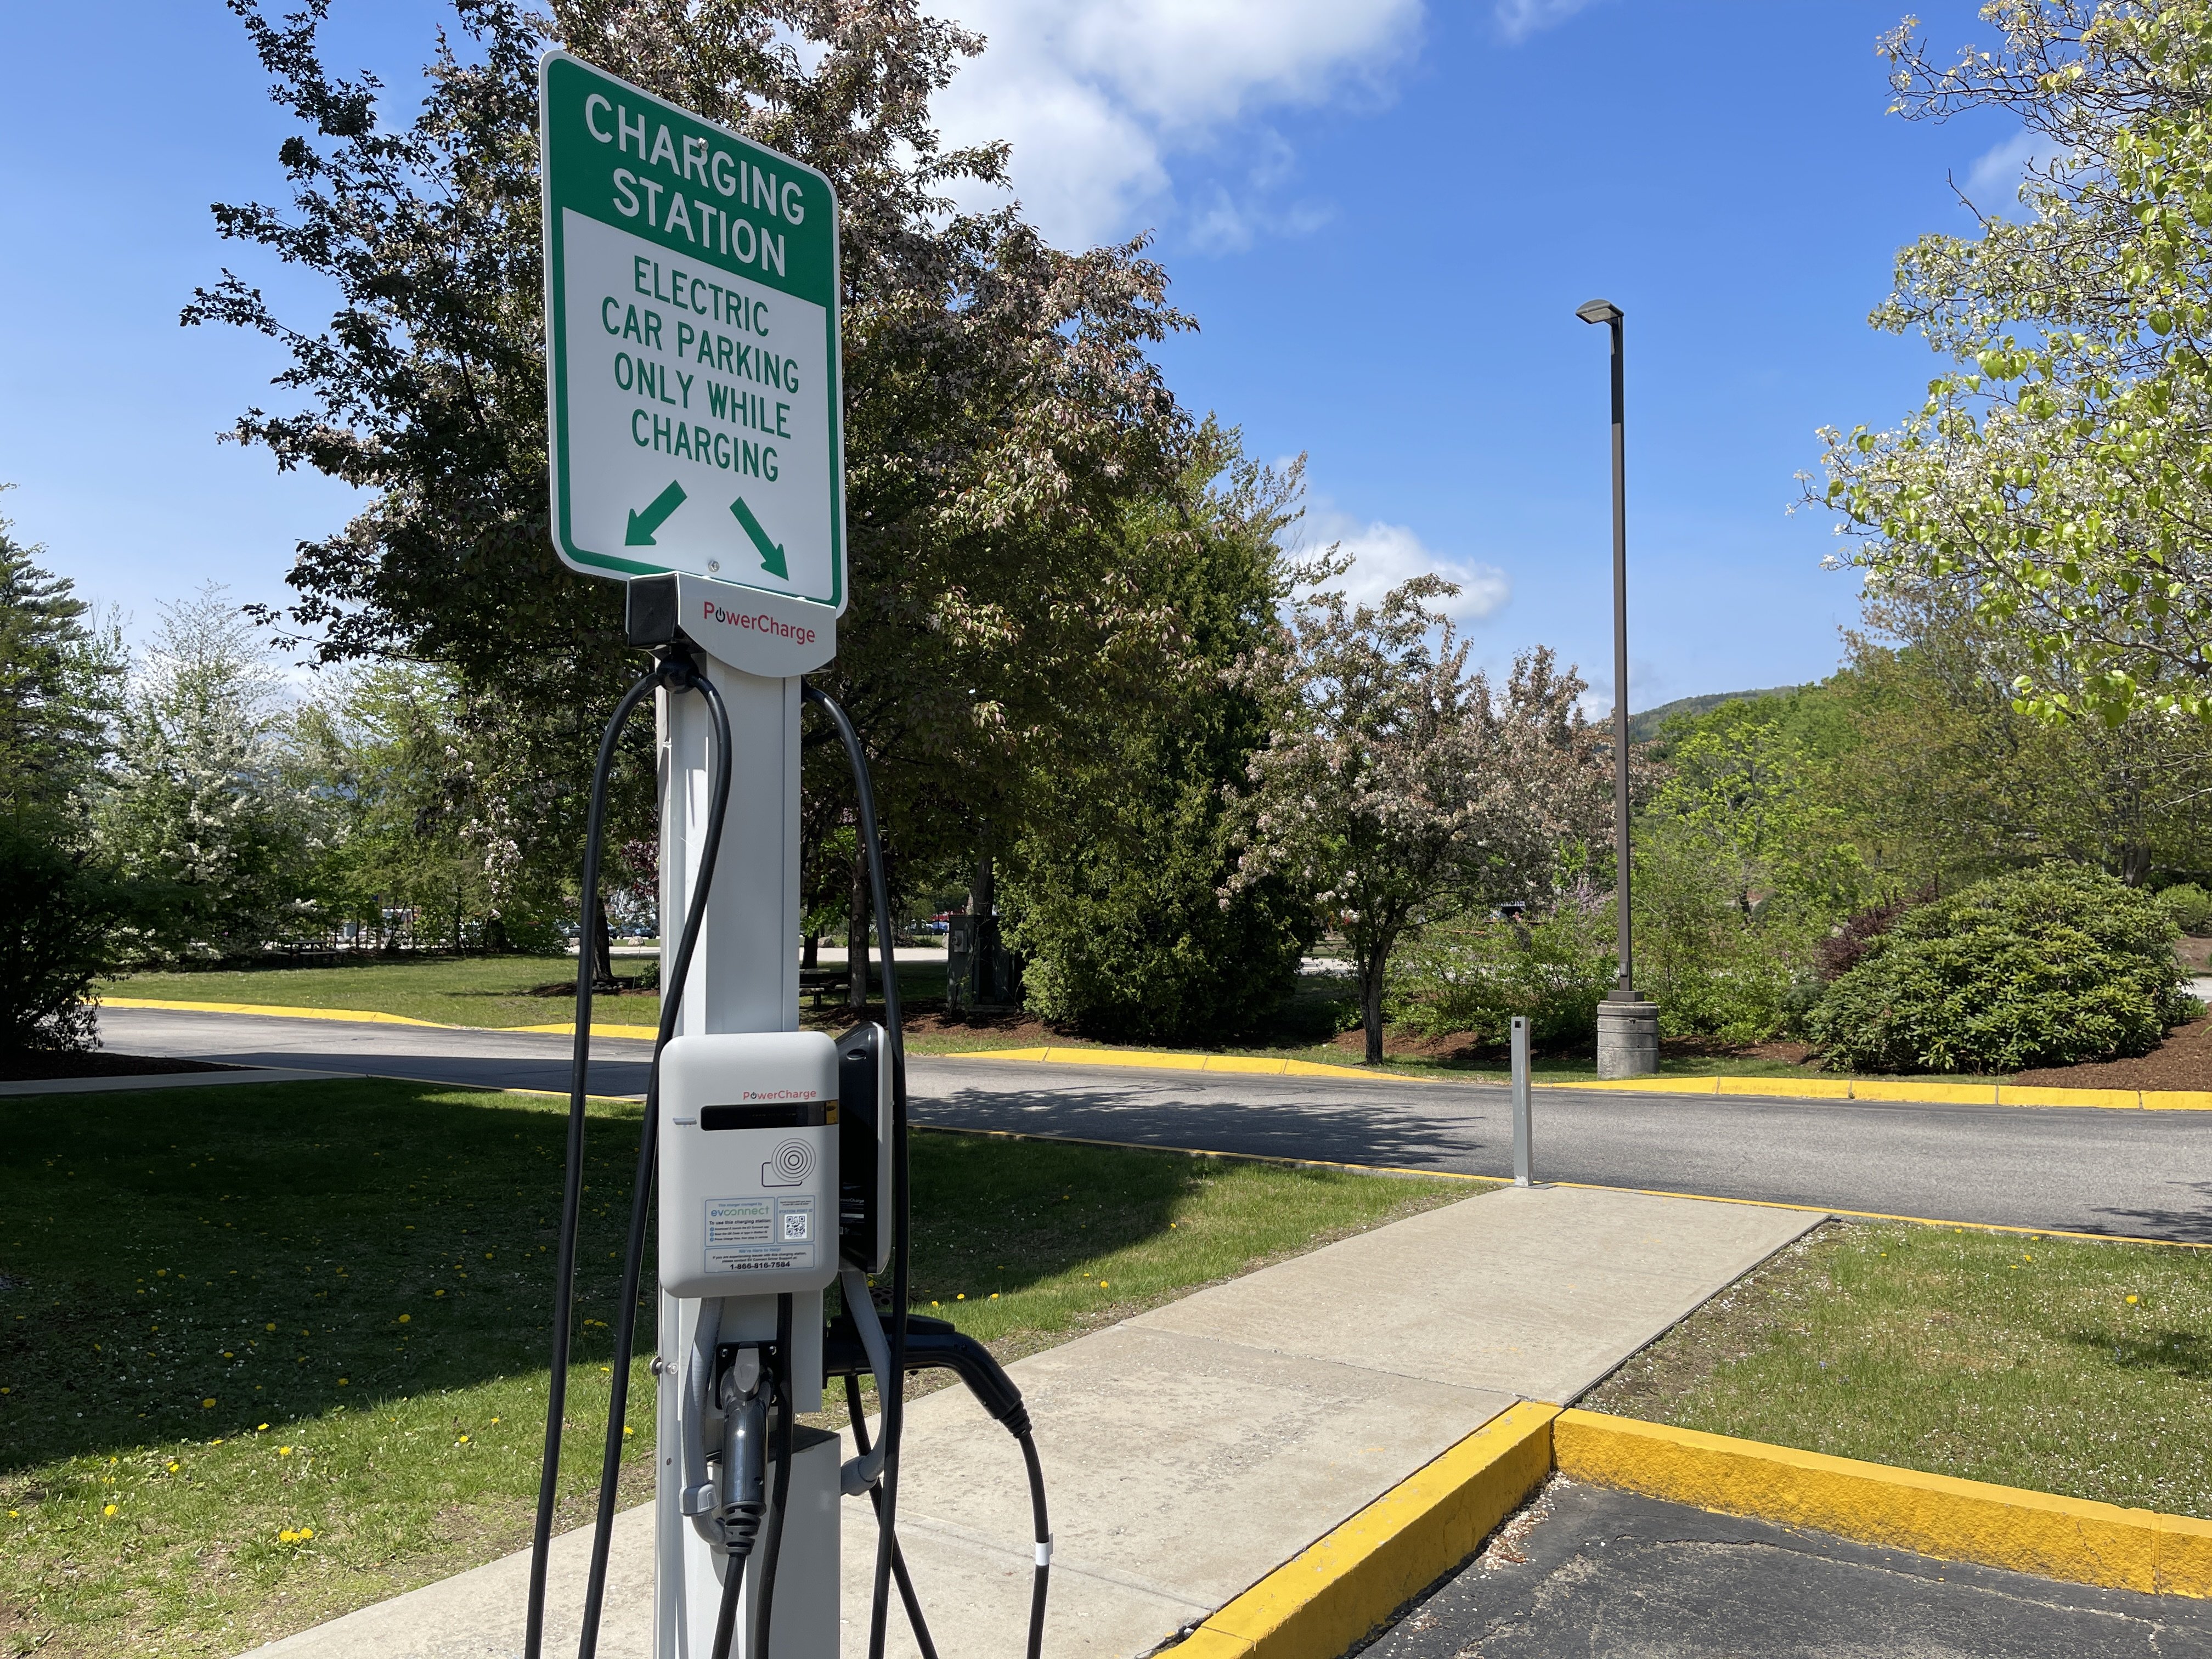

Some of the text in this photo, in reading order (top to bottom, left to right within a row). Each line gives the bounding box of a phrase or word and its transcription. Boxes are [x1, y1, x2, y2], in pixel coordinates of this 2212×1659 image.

[585, 93, 804, 225] CHARGING
[613, 168, 785, 278] STATION
[634, 255, 769, 337] ELECTRIC
[602, 296, 799, 394] CAR PARKING
[614, 352, 791, 439] ONLY WHILE
[632, 409, 778, 482] CHARGING
[704, 601, 816, 645] PowerCharge
[743, 1090, 817, 1100] PowerCharge
